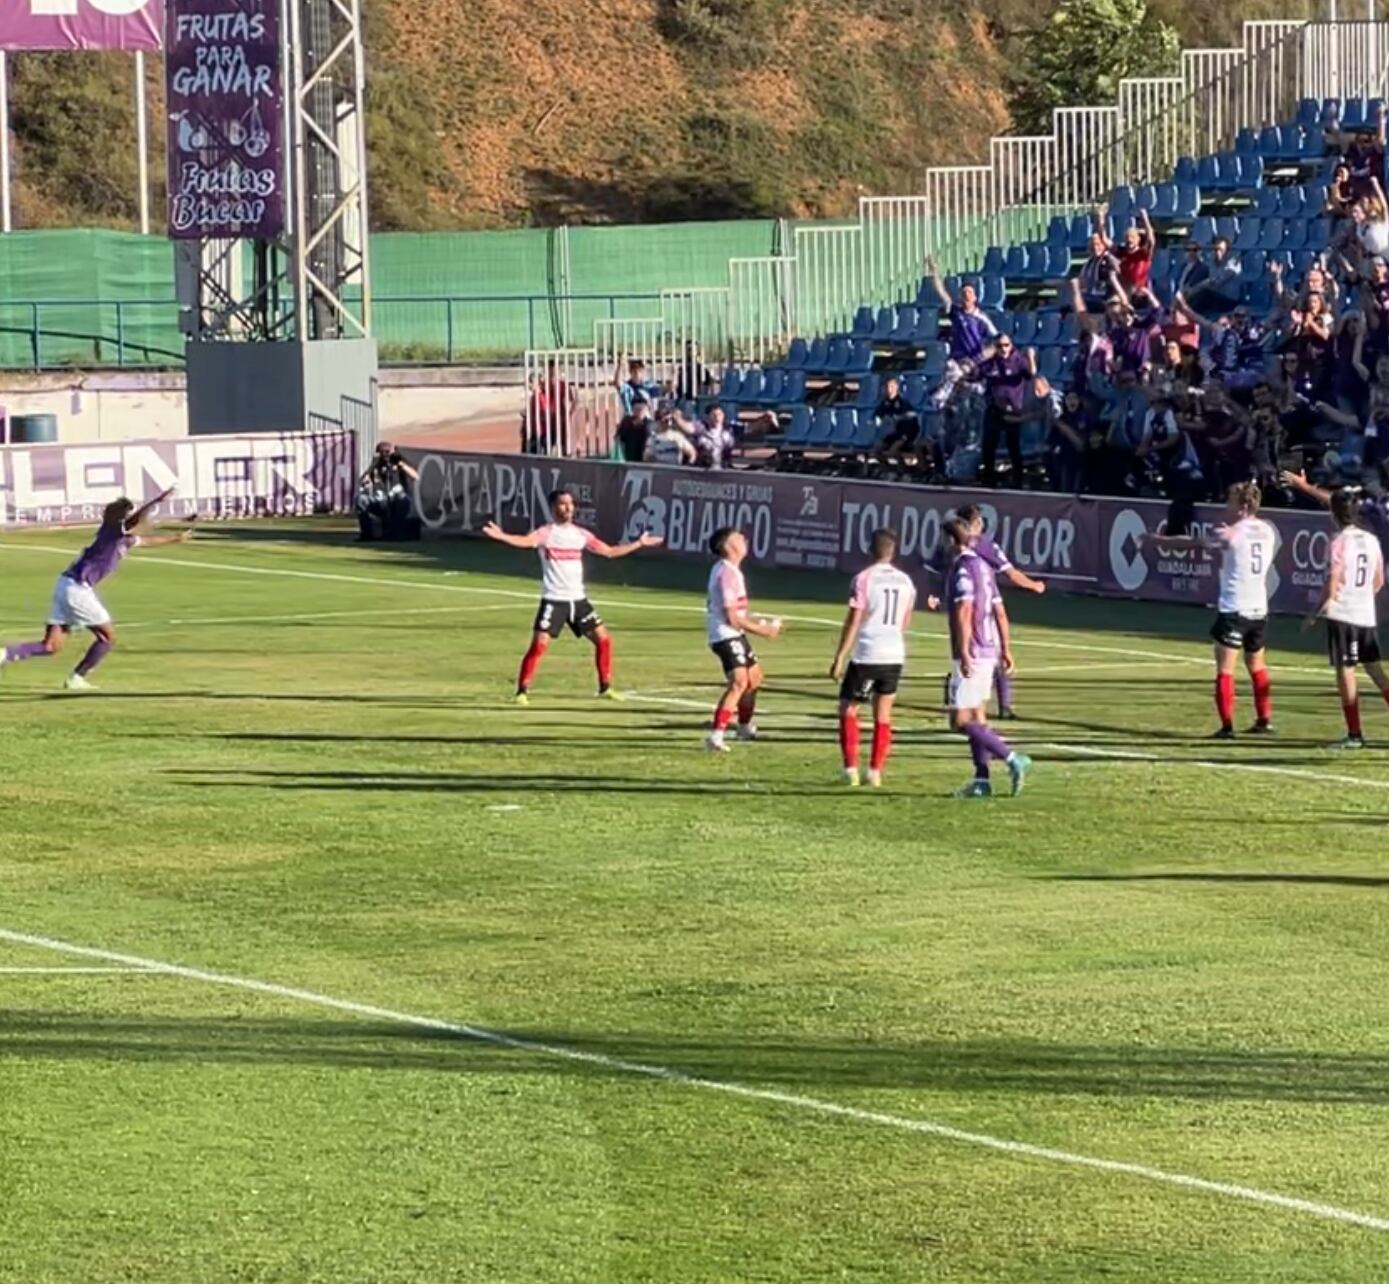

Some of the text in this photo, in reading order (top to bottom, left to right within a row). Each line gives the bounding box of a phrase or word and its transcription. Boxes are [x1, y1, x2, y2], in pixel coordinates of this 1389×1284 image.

[176, 11, 265, 43] FRUTAS
[195, 45, 245, 68] PARA
[173, 64, 274, 97] GANAR
[181, 160, 275, 196] Frutas
[172, 193, 265, 230] Bucar
[414, 454, 560, 532] CATAPAN
[1251, 542, 1263, 575] 5
[1356, 553, 1368, 588] 6
[883, 588, 900, 625] 11
